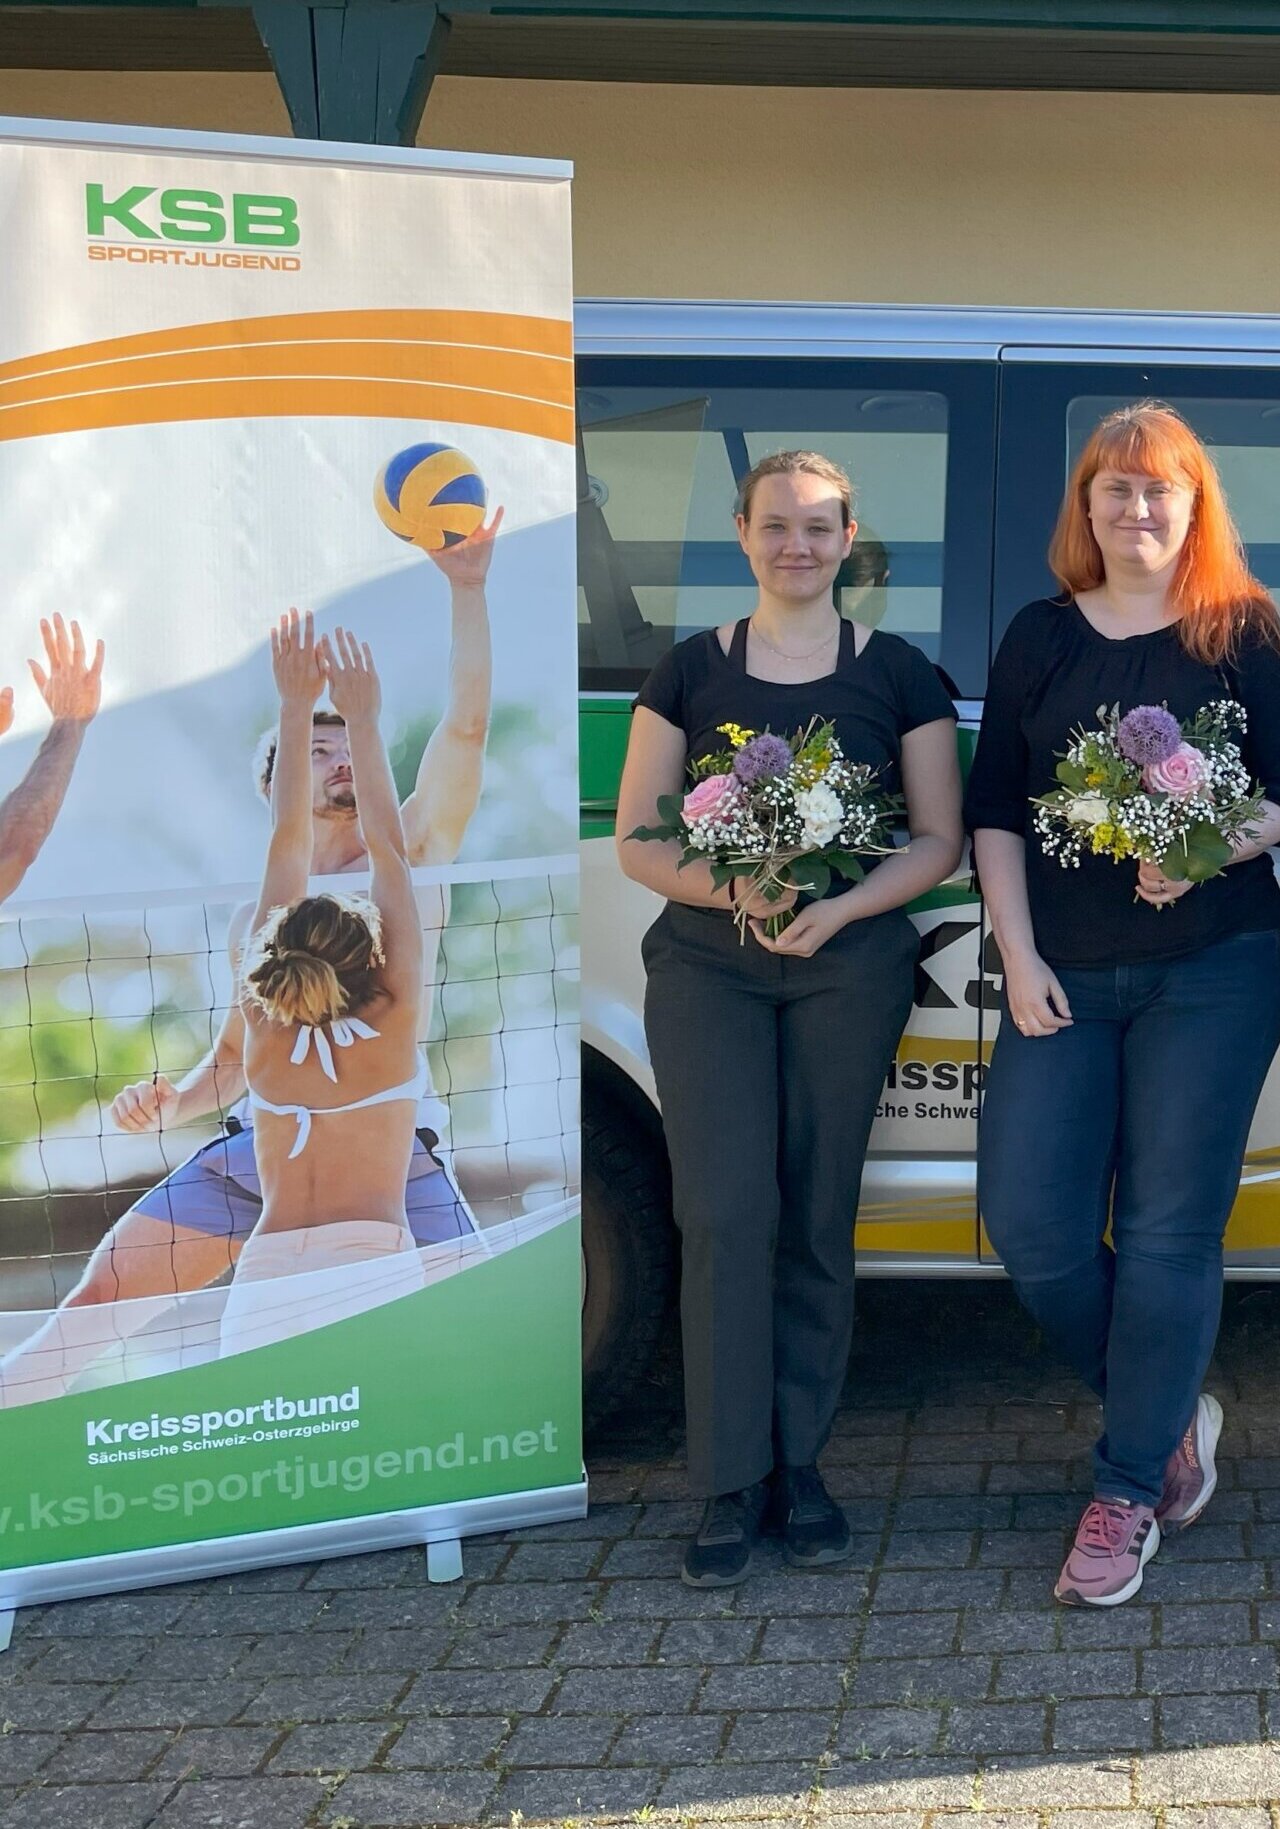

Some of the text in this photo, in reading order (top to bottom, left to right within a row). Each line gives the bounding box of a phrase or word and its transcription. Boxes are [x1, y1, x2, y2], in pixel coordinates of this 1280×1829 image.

[86, 183, 300, 247] KSB
[88, 245, 301, 272] SPORTJUGEND
[86, 1386, 360, 1446] Kreissportbund
[87, 1417, 360, 1466] Sächsische Schweiz-Osterzgebirge
